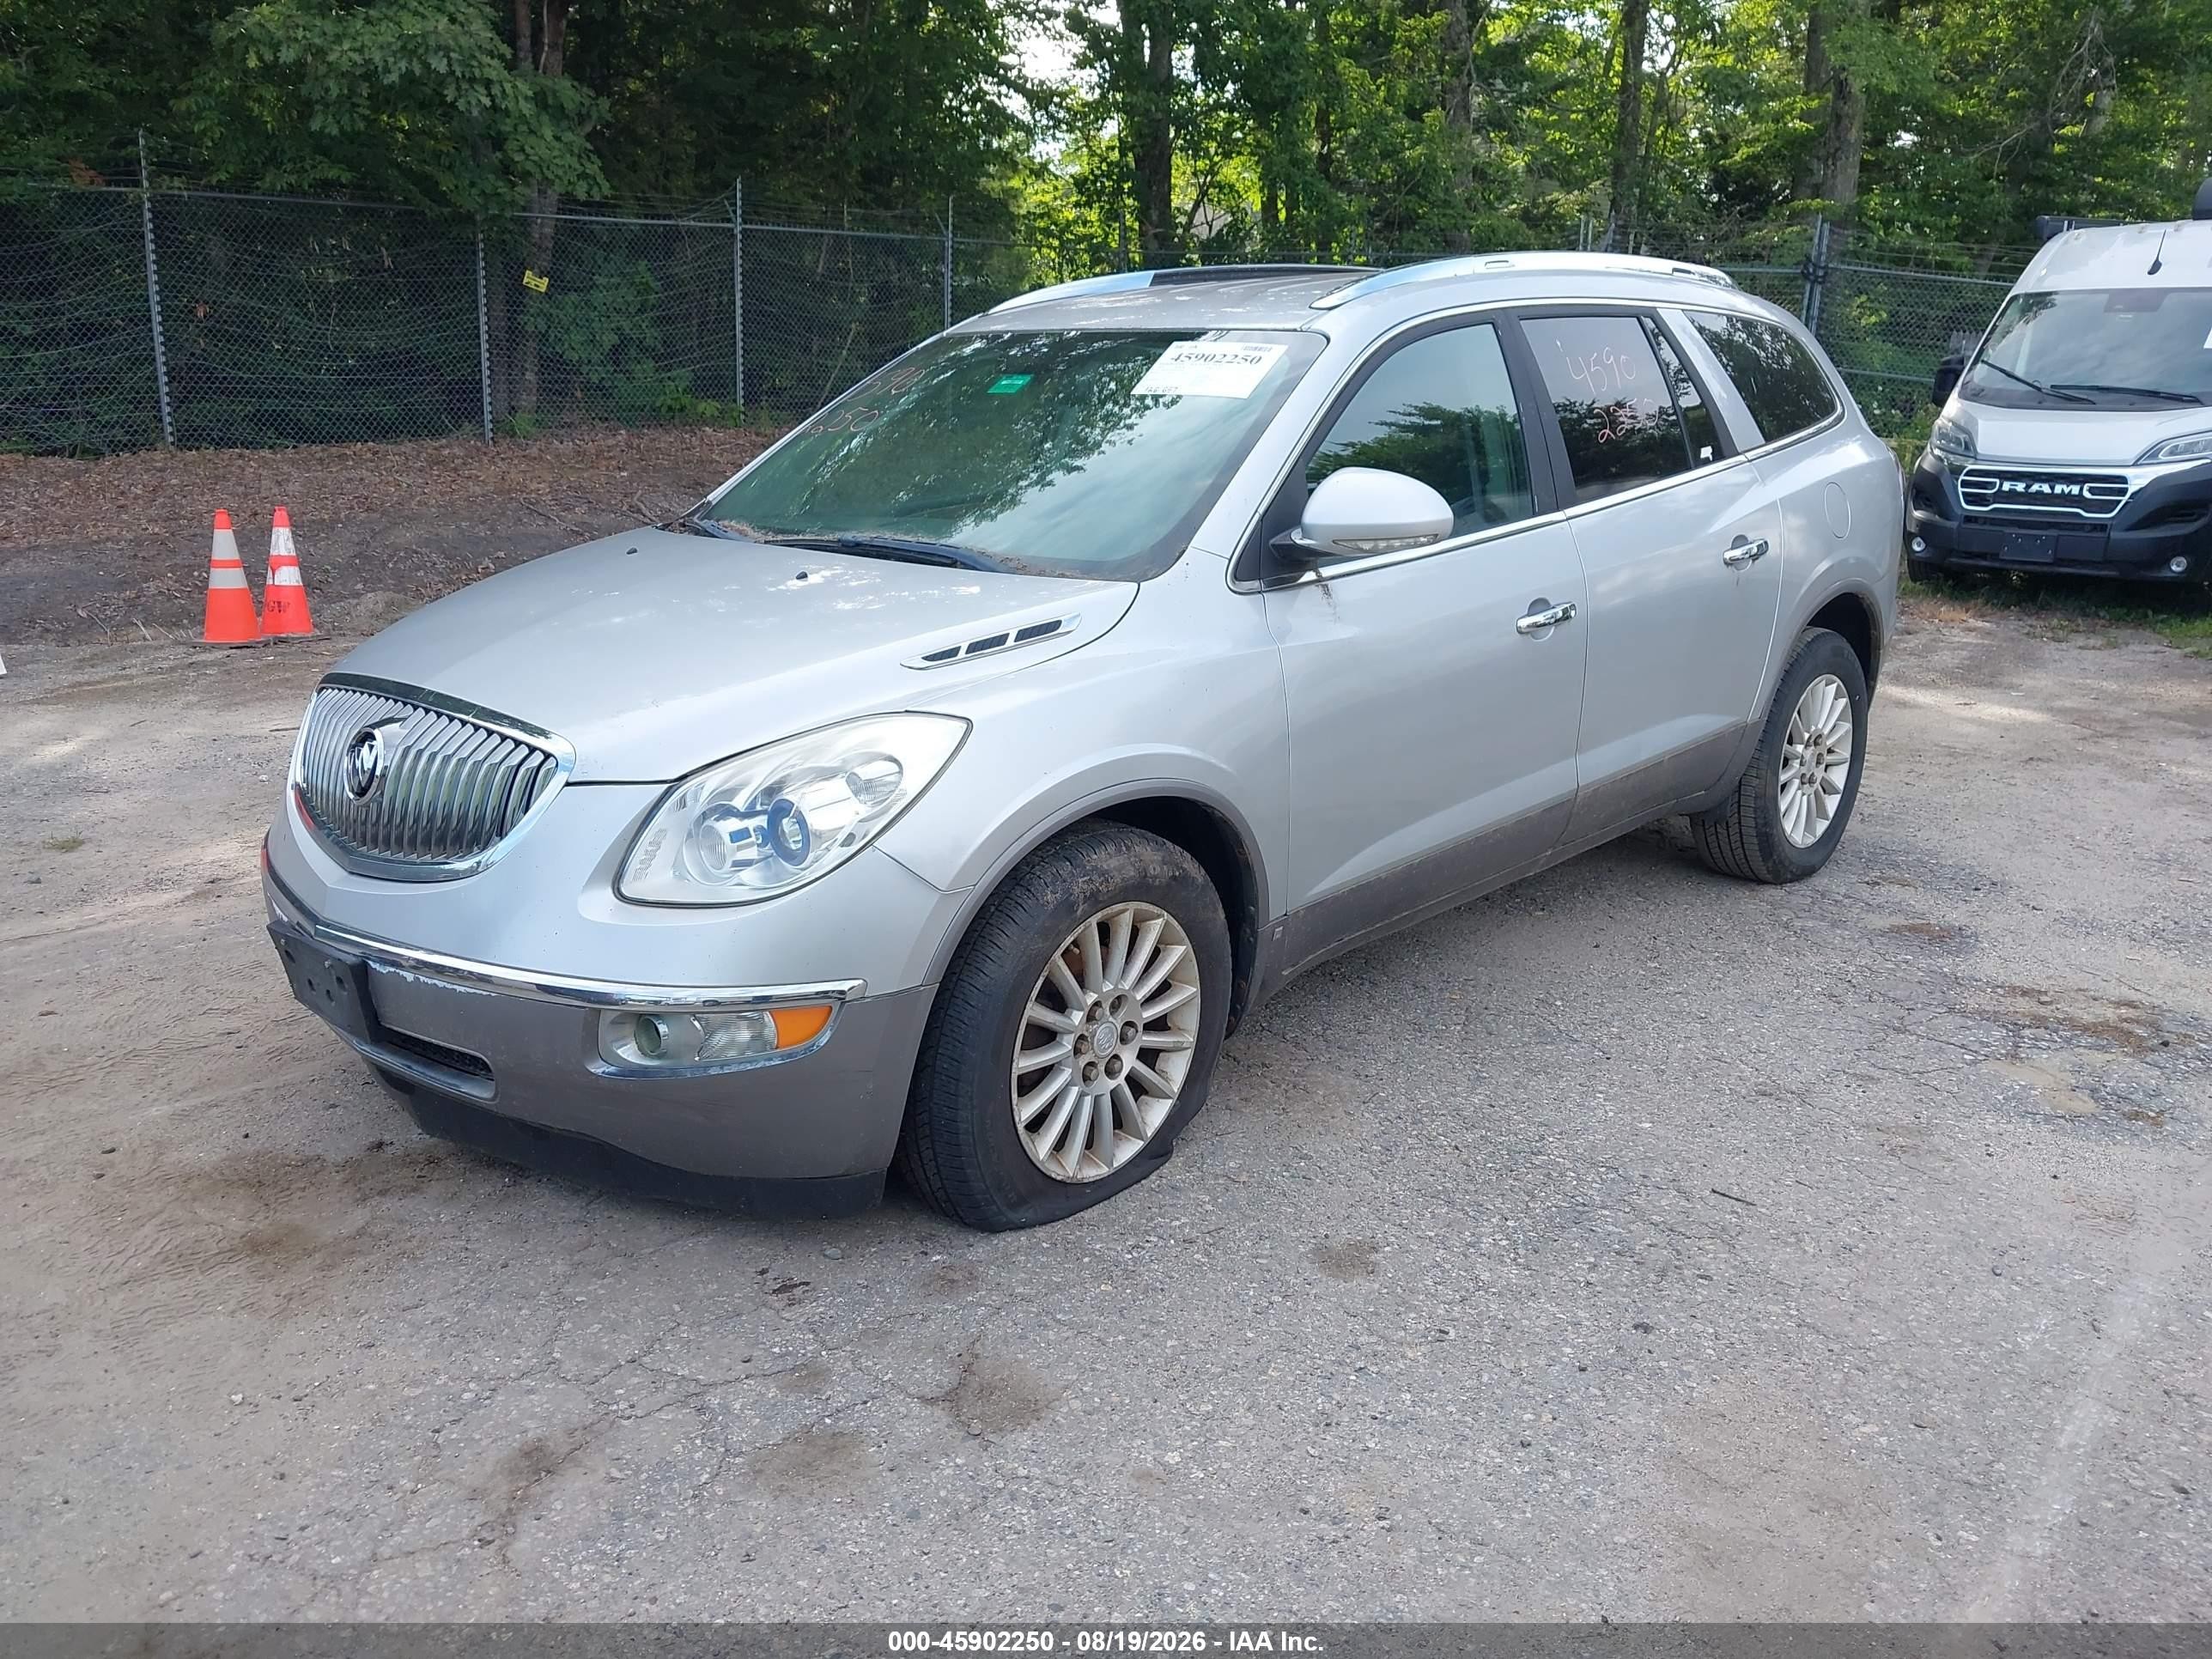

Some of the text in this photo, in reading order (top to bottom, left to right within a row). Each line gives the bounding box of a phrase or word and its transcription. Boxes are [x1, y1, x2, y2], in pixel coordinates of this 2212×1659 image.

[1170, 352, 1262, 365] 45902250
[1565, 346, 1637, 395] 4590
[2002, 481, 2081, 495] RAM
